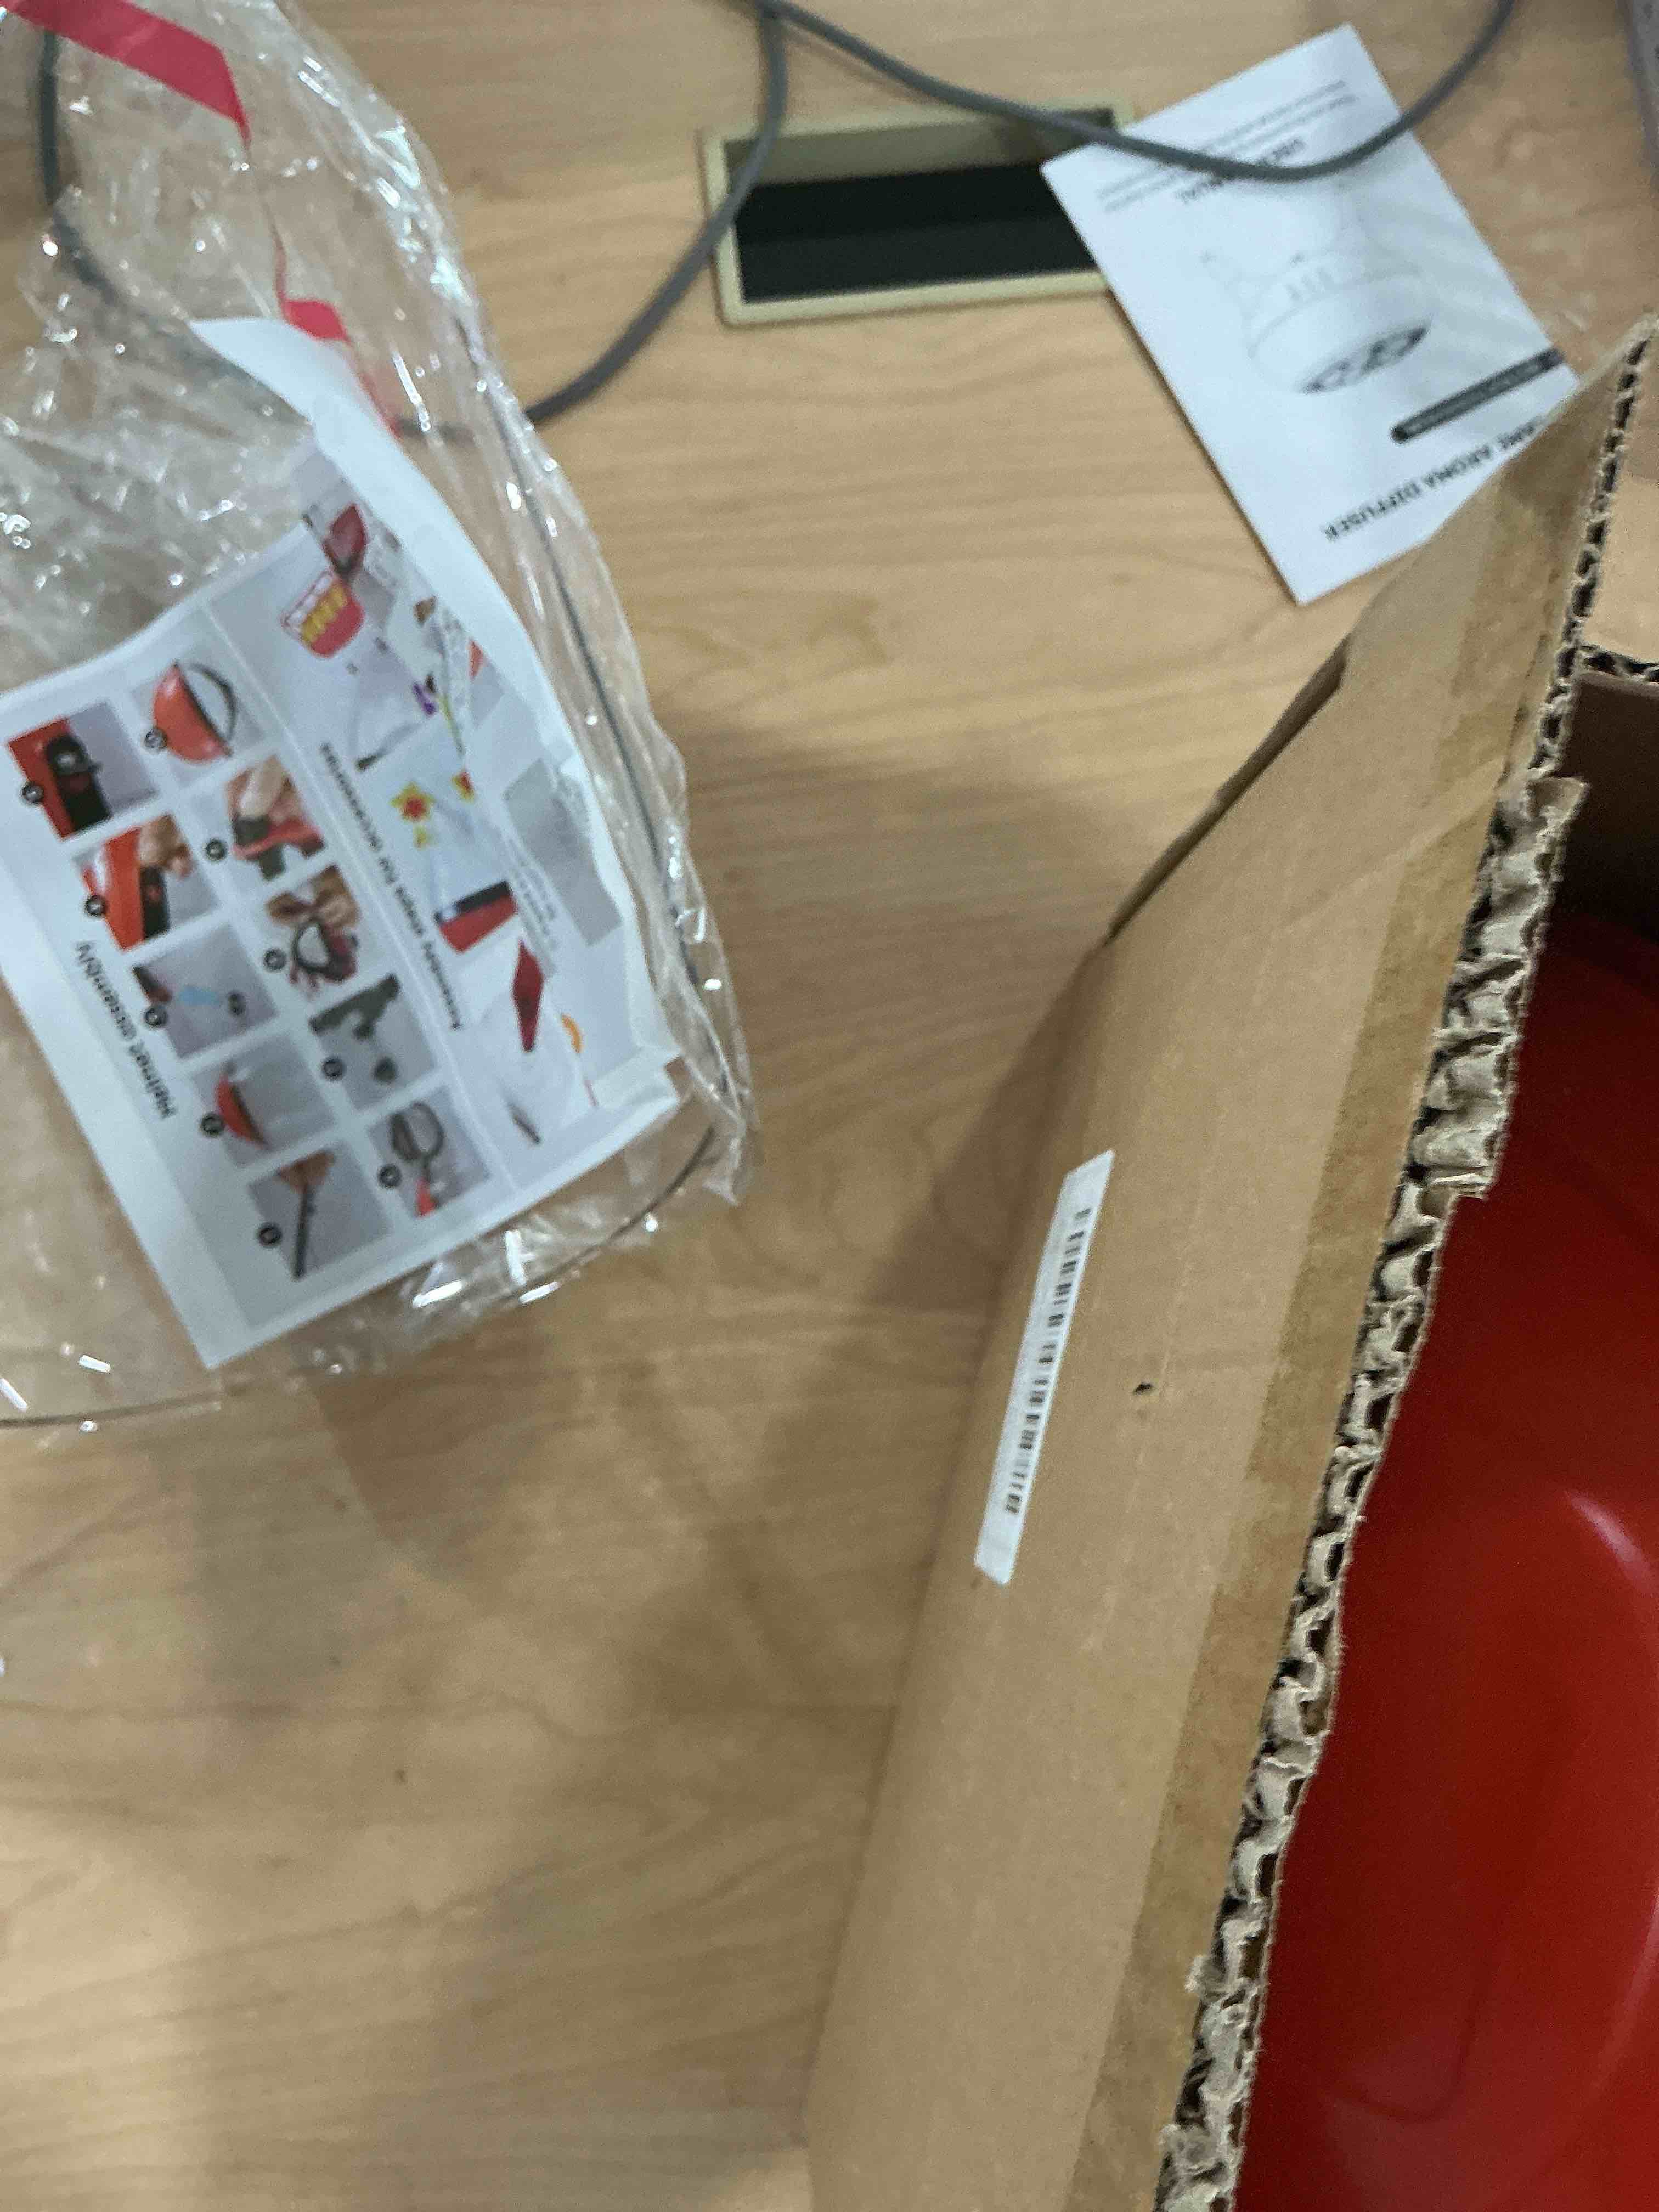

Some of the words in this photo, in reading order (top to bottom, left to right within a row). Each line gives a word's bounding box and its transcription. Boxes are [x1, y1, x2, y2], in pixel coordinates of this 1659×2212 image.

[1422, 443, 1493, 488] AROMA
[1321, 479, 1422, 541] DIFFUSER
[75, 940, 137, 1041] assembly
[128, 1041, 177, 1119] Helmet
